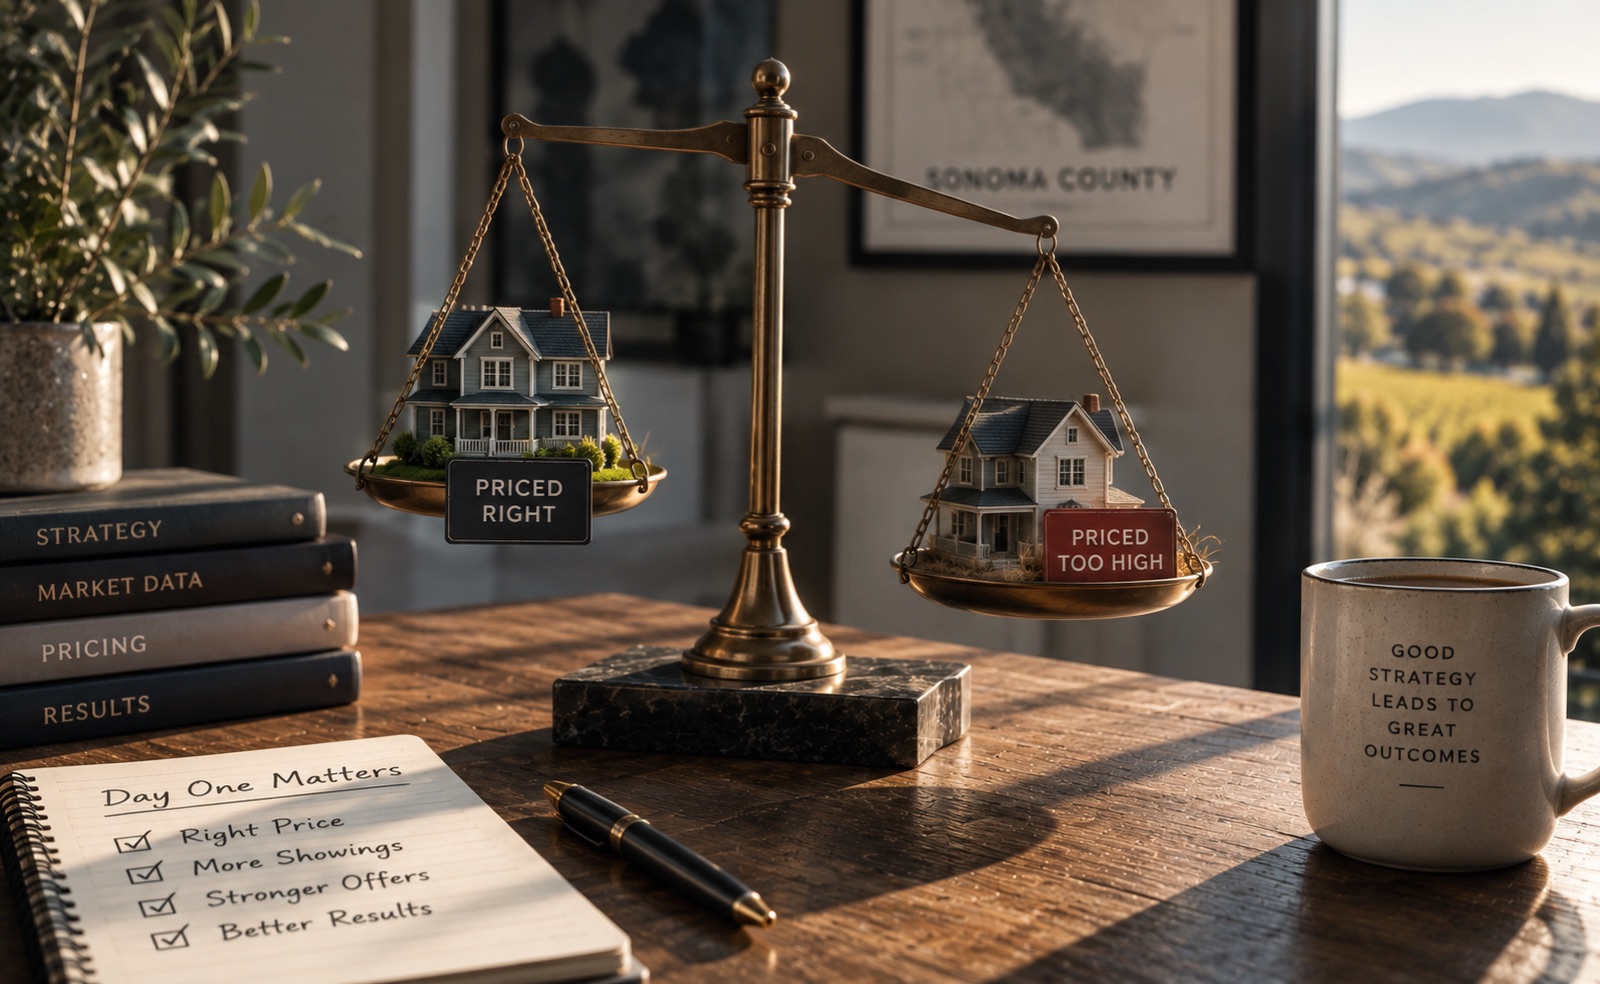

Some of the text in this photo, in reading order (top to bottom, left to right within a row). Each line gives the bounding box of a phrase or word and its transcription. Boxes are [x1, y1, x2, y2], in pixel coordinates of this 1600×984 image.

[925, 166, 1178, 192] SONOMA COUNTY
[476, 479, 563, 496] PRICED
[482, 505, 556, 522] RIGHT
[37, 520, 162, 546] STRATEGY
[1072, 529, 1149, 546] PRICED
[1058, 554, 1163, 572] TOO HIGH
[37, 571, 203, 602] MARKET DATA
[42, 635, 147, 662] PRICING
[1391, 644, 1455, 659] GOOD
[1369, 667, 1477, 686] STRATEGY
[43, 695, 151, 725] RESULTS
[1372, 693, 1474, 712] LEADS TO
[1388, 721, 1456, 737] GREAT
[1364, 744, 1480, 763] OUTCOMES
[101, 764, 402, 809] Day One Matters
[180, 815, 345, 847] Right Price
[193, 840, 404, 876] More Showings
[205, 869, 430, 908] Stronger Offers
[218, 902, 433, 941] Better Results
